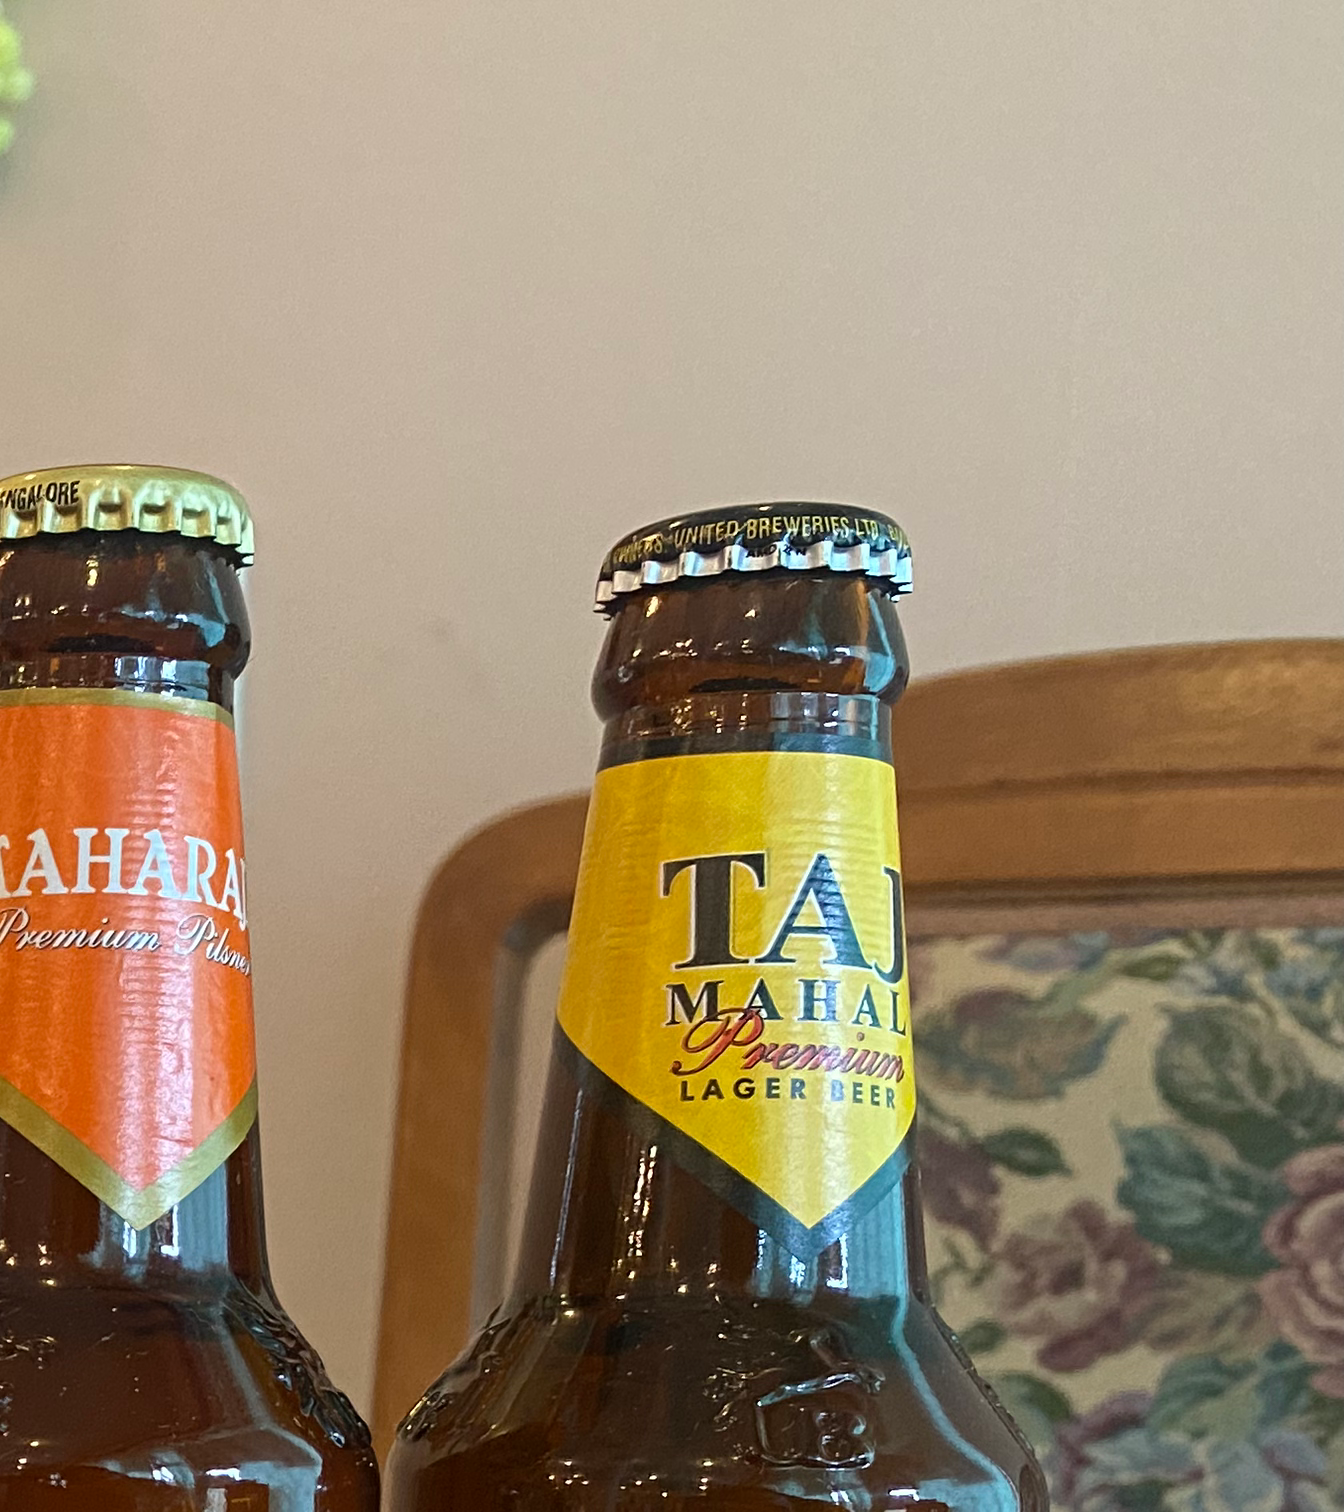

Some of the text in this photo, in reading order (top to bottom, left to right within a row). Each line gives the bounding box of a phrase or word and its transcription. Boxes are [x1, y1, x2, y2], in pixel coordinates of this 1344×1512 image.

[675, 520, 738, 549] UNITED
[747, 515, 850, 541] BREWERIES
[660, 851, 905, 984] TAJ
[664, 976, 907, 1037] MAHAL
[669, 1007, 905, 1083] Premium
[680, 1077, 895, 1109] LAGER BEER
